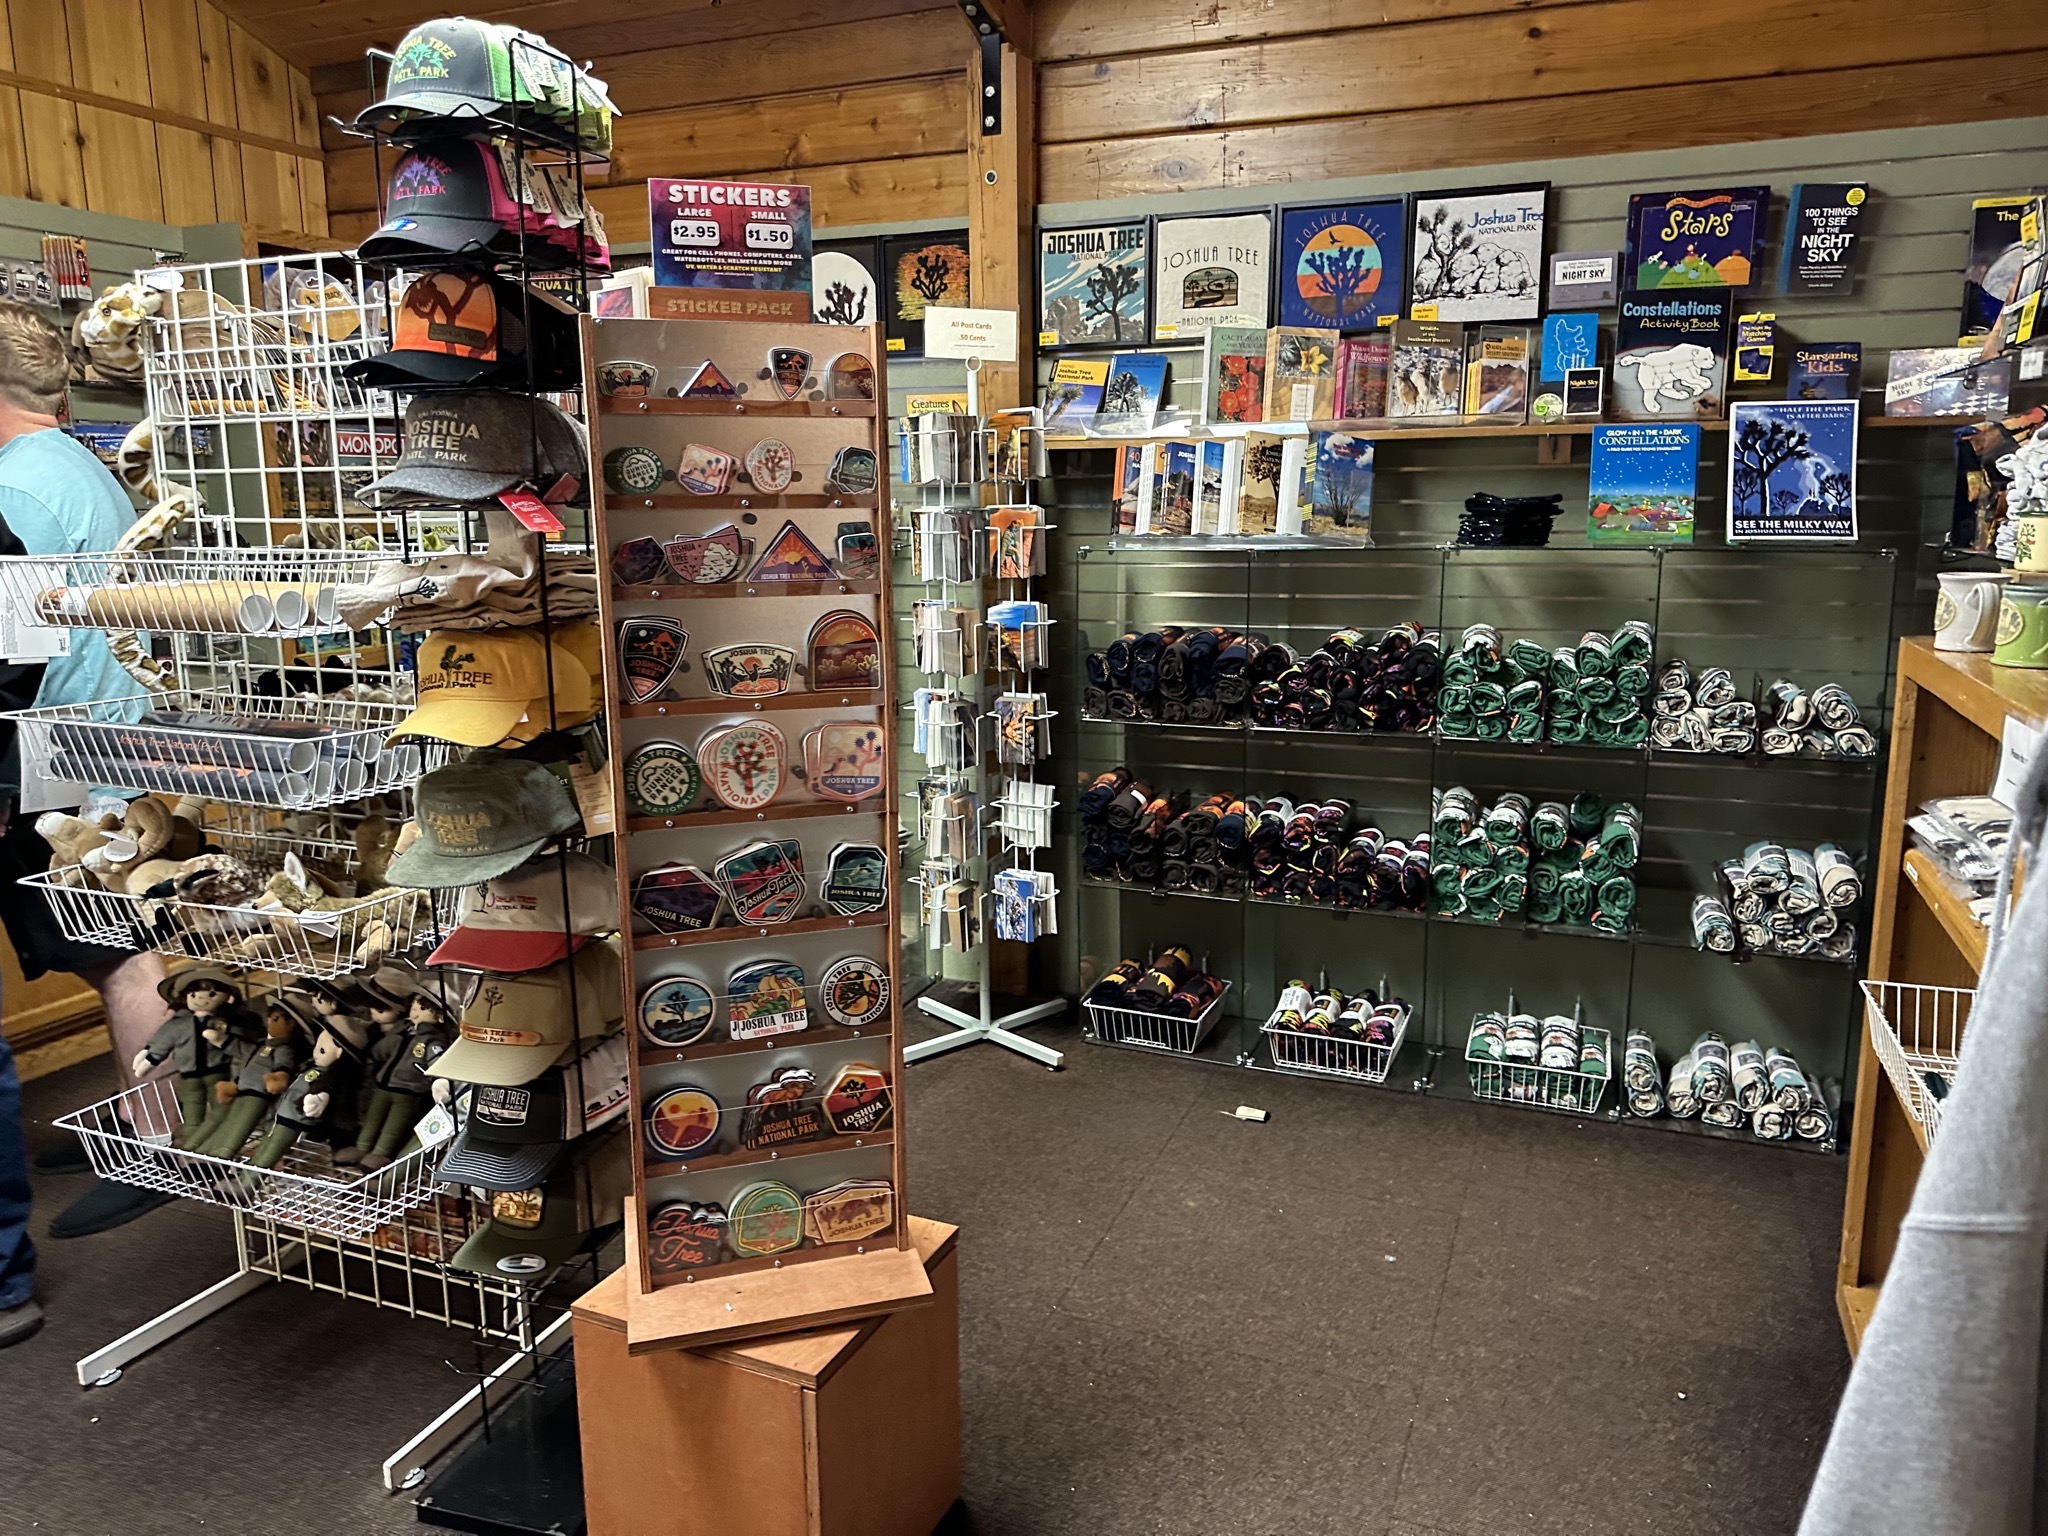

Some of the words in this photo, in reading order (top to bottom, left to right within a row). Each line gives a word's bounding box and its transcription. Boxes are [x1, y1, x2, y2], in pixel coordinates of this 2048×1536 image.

[430, 36, 457, 60] TREE
[420, 66, 449, 78] PARK
[668, 184, 791, 207] STICKERS
[677, 208, 712, 218] LARGE
[751, 211, 787, 220] SMALL
[1467, 208, 1516, 229] Joshua
[1805, 208, 1821, 218] 100
[1822, 206, 1859, 217] THINGS
[1996, 211, 2020, 221] The
[1660, 210, 1734, 242] Stars
[1812, 218, 1826, 227] TO
[1827, 216, 1848, 226] SEE
[673, 226, 717, 239] $2.95
[748, 230, 789, 243] $1.50
[1295, 211, 1348, 249] JOSHUA
[1356, 213, 1389, 241] TREE
[1478, 225, 1515, 236] NATIONAL
[1516, 223, 1537, 233] PARK
[1047, 232, 1105, 256] JOSHUA
[1109, 228, 1144, 250] TREE
[1801, 234, 1855, 249] NIGHT
[661, 248, 684, 256] GREAT
[1071, 251, 1103, 262] NATIONAL
[1104, 250, 1121, 260] PARK
[1163, 246, 1219, 272] JOSHUA
[1227, 247, 1259, 267] TREE
[1807, 248, 1844, 262] SKY
[1562, 270, 1588, 280] NIGHT
[1588, 268, 1606, 279] SKY
[666, 299, 743, 316] STICKER
[744, 301, 793, 316] PACK
[1302, 307, 1351, 327] NATIONAL
[1354, 302, 1377, 321] PARK
[1622, 300, 1722, 317] Constellations
[960, 321, 974, 329] Post
[975, 322, 993, 330] Cards
[1181, 315, 1217, 327] NATIONAL
[1639, 317, 1689, 333] Activity
[1689, 318, 1721, 331] Book
[969, 334, 987, 342] Cents
[1796, 351, 1859, 363] Stargazing
[1807, 361, 1845, 374] Kids
[1569, 380, 1586, 388] Night
[1586, 379, 1599, 388] Sky
[1892, 381, 1913, 392] Night
[1897, 389, 1911, 397] Sky
[911, 399, 950, 410] Creatures
[407, 419, 481, 440] JOSHUA
[1606, 429, 1627, 437] GLOW
[410, 435, 461, 452] TREE
[1599, 435, 1691, 446] CONSTELLATIONS
[435, 451, 468, 463] PARK
[1735, 520, 1757, 530] SEE
[1758, 520, 1781, 530] THE
[1782, 520, 1822, 530] MILKY
[1822, 520, 1851, 530] WAY
[670, 543, 697, 555] JOSHUA
[672, 553, 689, 563] TREE
[851, 625, 869, 637] TREE
[729, 648, 758, 658] JOSHUA
[760, 648, 776, 656] TREE
[452, 671, 493, 685] TREE
[452, 681, 477, 689] Park
[121, 733, 147, 746] Joshua
[149, 736, 165, 748] Tree
[201, 741, 221, 754] Park
[720, 731, 757, 760] JOSHUA
[757, 733, 776, 759] TREE
[626, 756, 649, 798] JOSHUA
[648, 749, 680, 758] TREE
[644, 761, 677, 794] JUNIOR
[649, 767, 684, 801] RANGER
[720, 771, 766, 805] NATIONAL
[763, 766, 777, 797] PARK
[738, 886, 773, 915] JOSHUA
[769, 875, 795, 895] TREE
[862, 890, 882, 898] TREE
[641, 904, 678, 923] JOSHUA
[679, 914, 703, 929] TREE
[832, 965, 851, 979] TREE
[825, 980, 836, 1012] JOSHUA
[860, 993, 889, 1023] NATIONAL
[741, 1014, 777, 1032] JOSHUA
[781, 1010, 806, 1024] TREE
[752, 1025, 779, 1037] NATIONAL
[780, 1023, 795, 1032] PARK
[507, 1090, 527, 1106] TREE
[504, 1103, 524, 1111] PARK
[842, 1101, 884, 1127] JOSHUA
[762, 1119, 792, 1134] JOSHUA
[793, 1114, 813, 1127] TREE
[853, 1112, 877, 1127] TREE
[758, 1129, 797, 1146] NATIONAL
[798, 1123, 820, 1136] PARK
[652, 1212, 720, 1240] Joshua
[828, 1222, 863, 1238] JOSHUA
[864, 1216, 886, 1228] TREE
[655, 1236, 704, 1264] Tree
